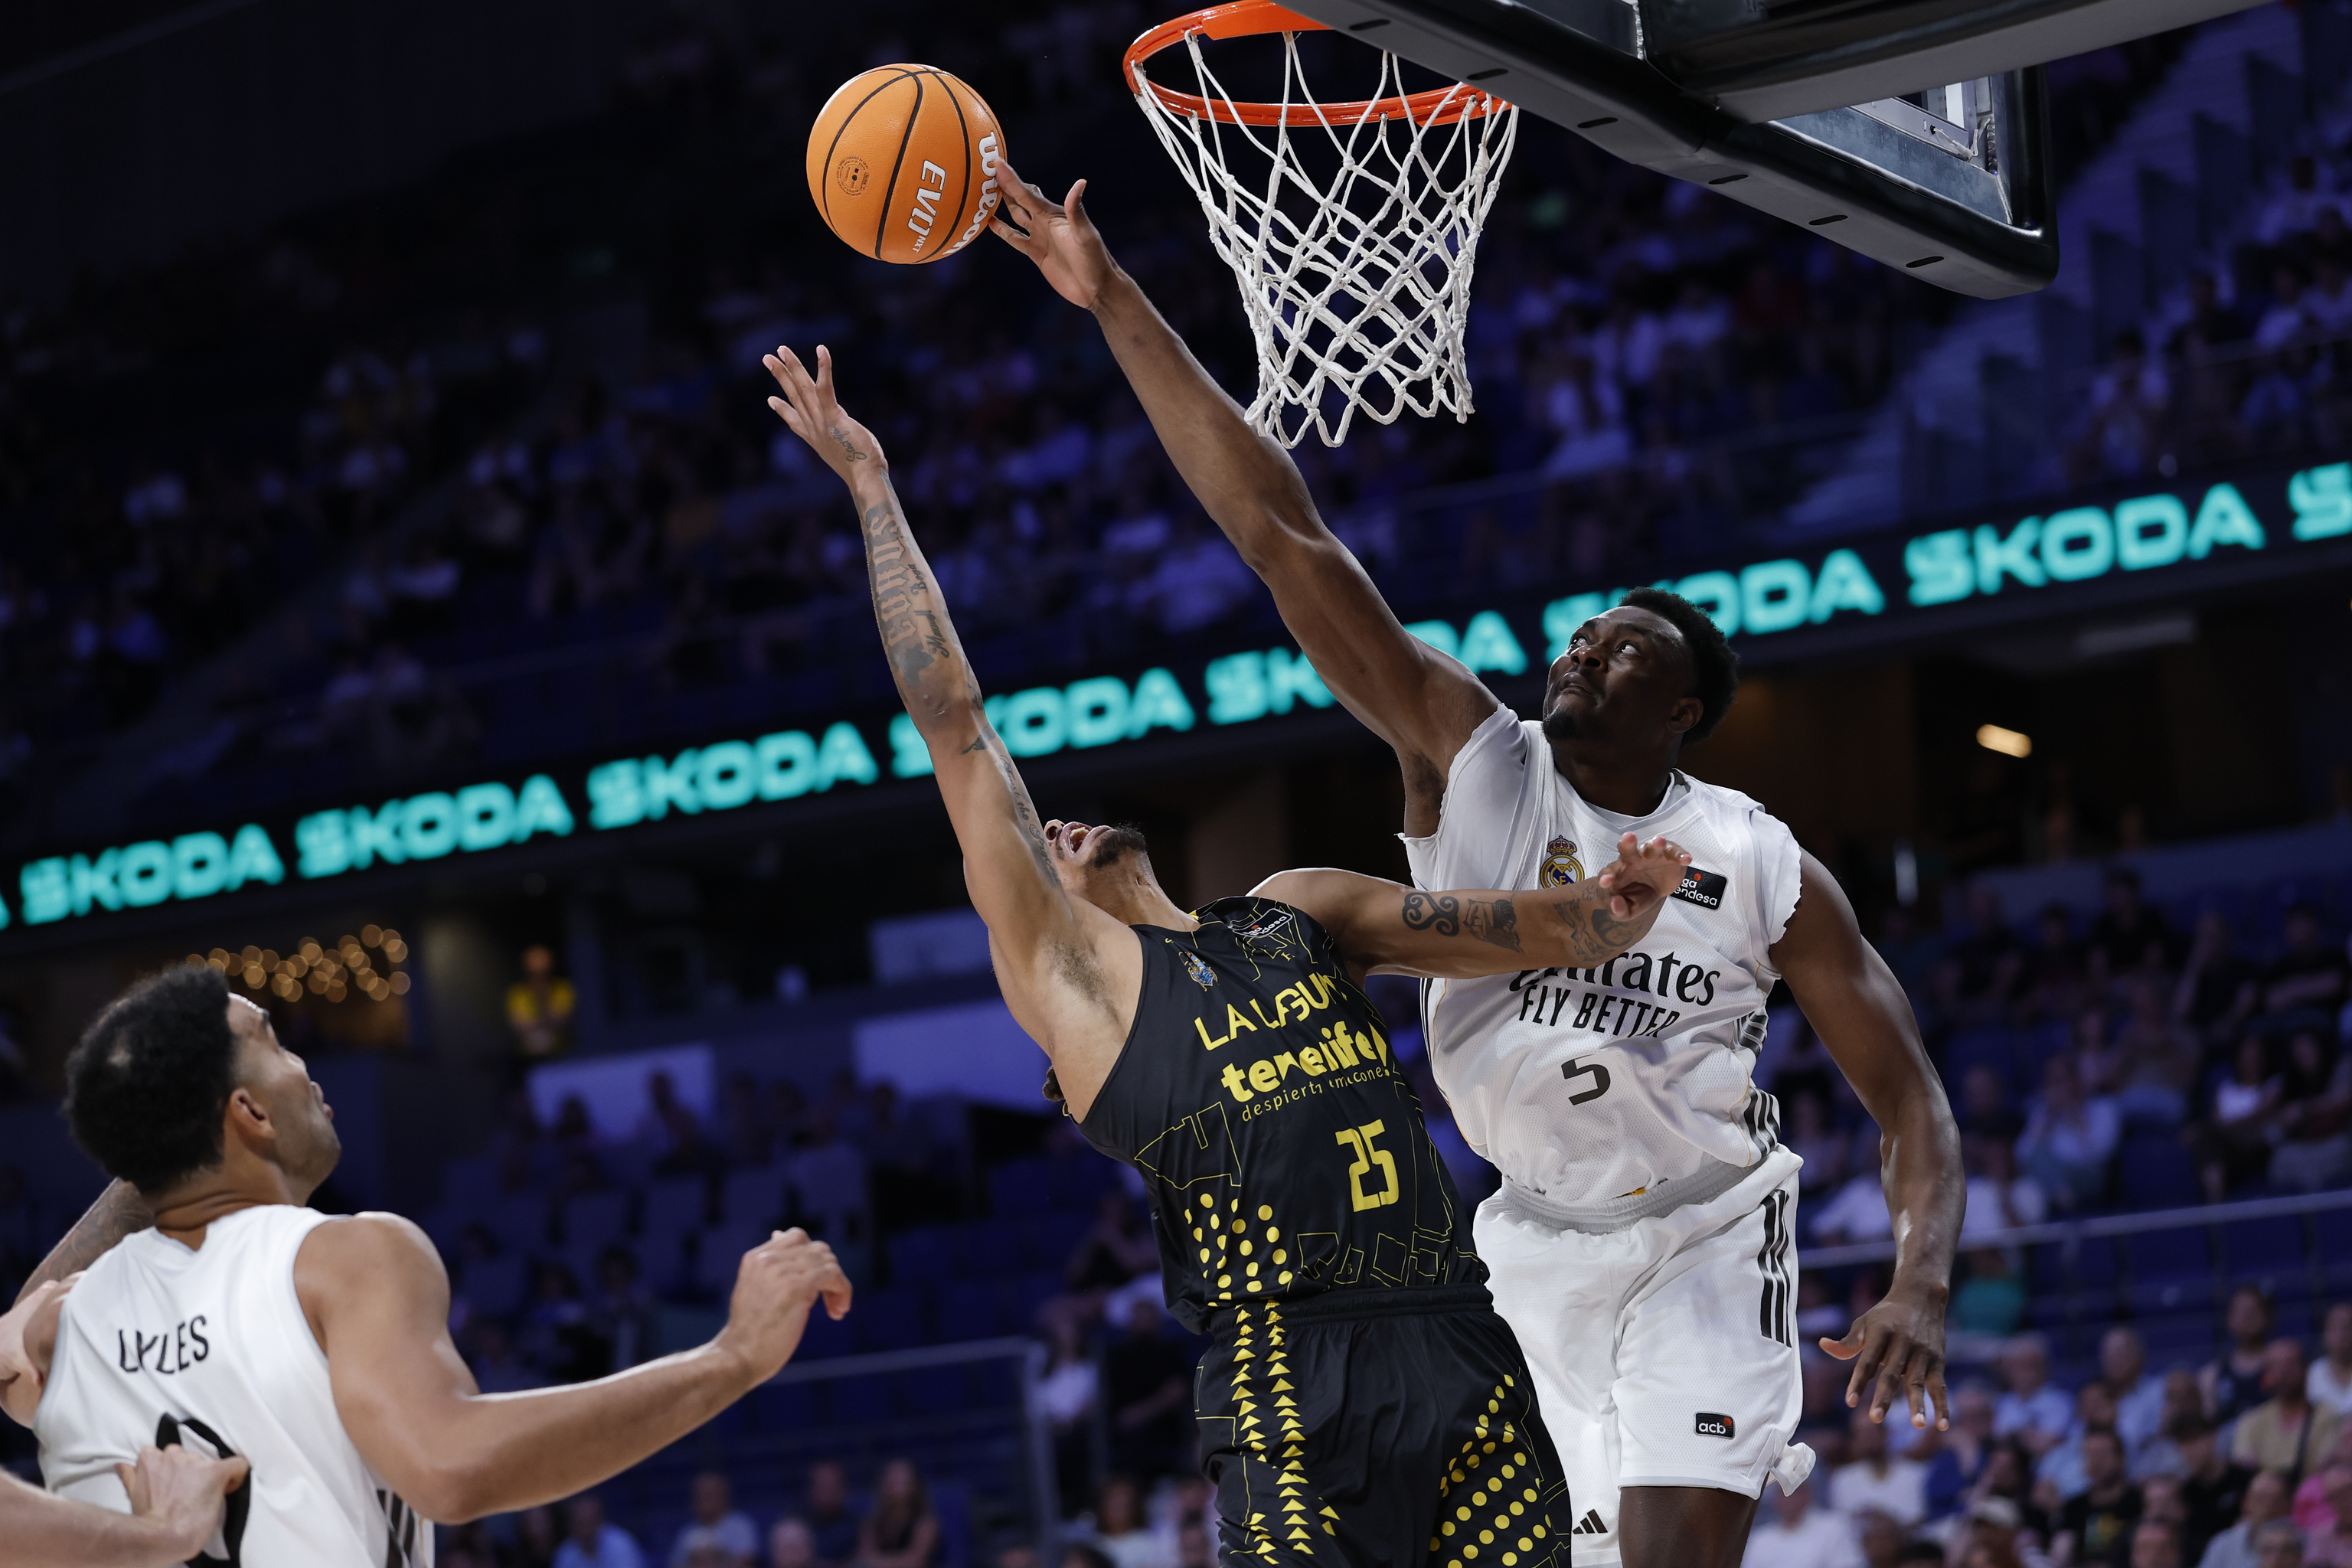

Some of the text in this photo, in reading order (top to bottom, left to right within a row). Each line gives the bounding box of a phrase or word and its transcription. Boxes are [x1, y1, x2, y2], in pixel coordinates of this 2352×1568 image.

[913, 235, 926, 253] NXT
[1194, 1004, 1258, 1050] LA
[1519, 985, 1571, 1026] FLY
[1334, 1119, 1399, 1212] 25
[119, 1315, 209, 1374] LYLES
[1698, 1422, 1726, 1434] acb
